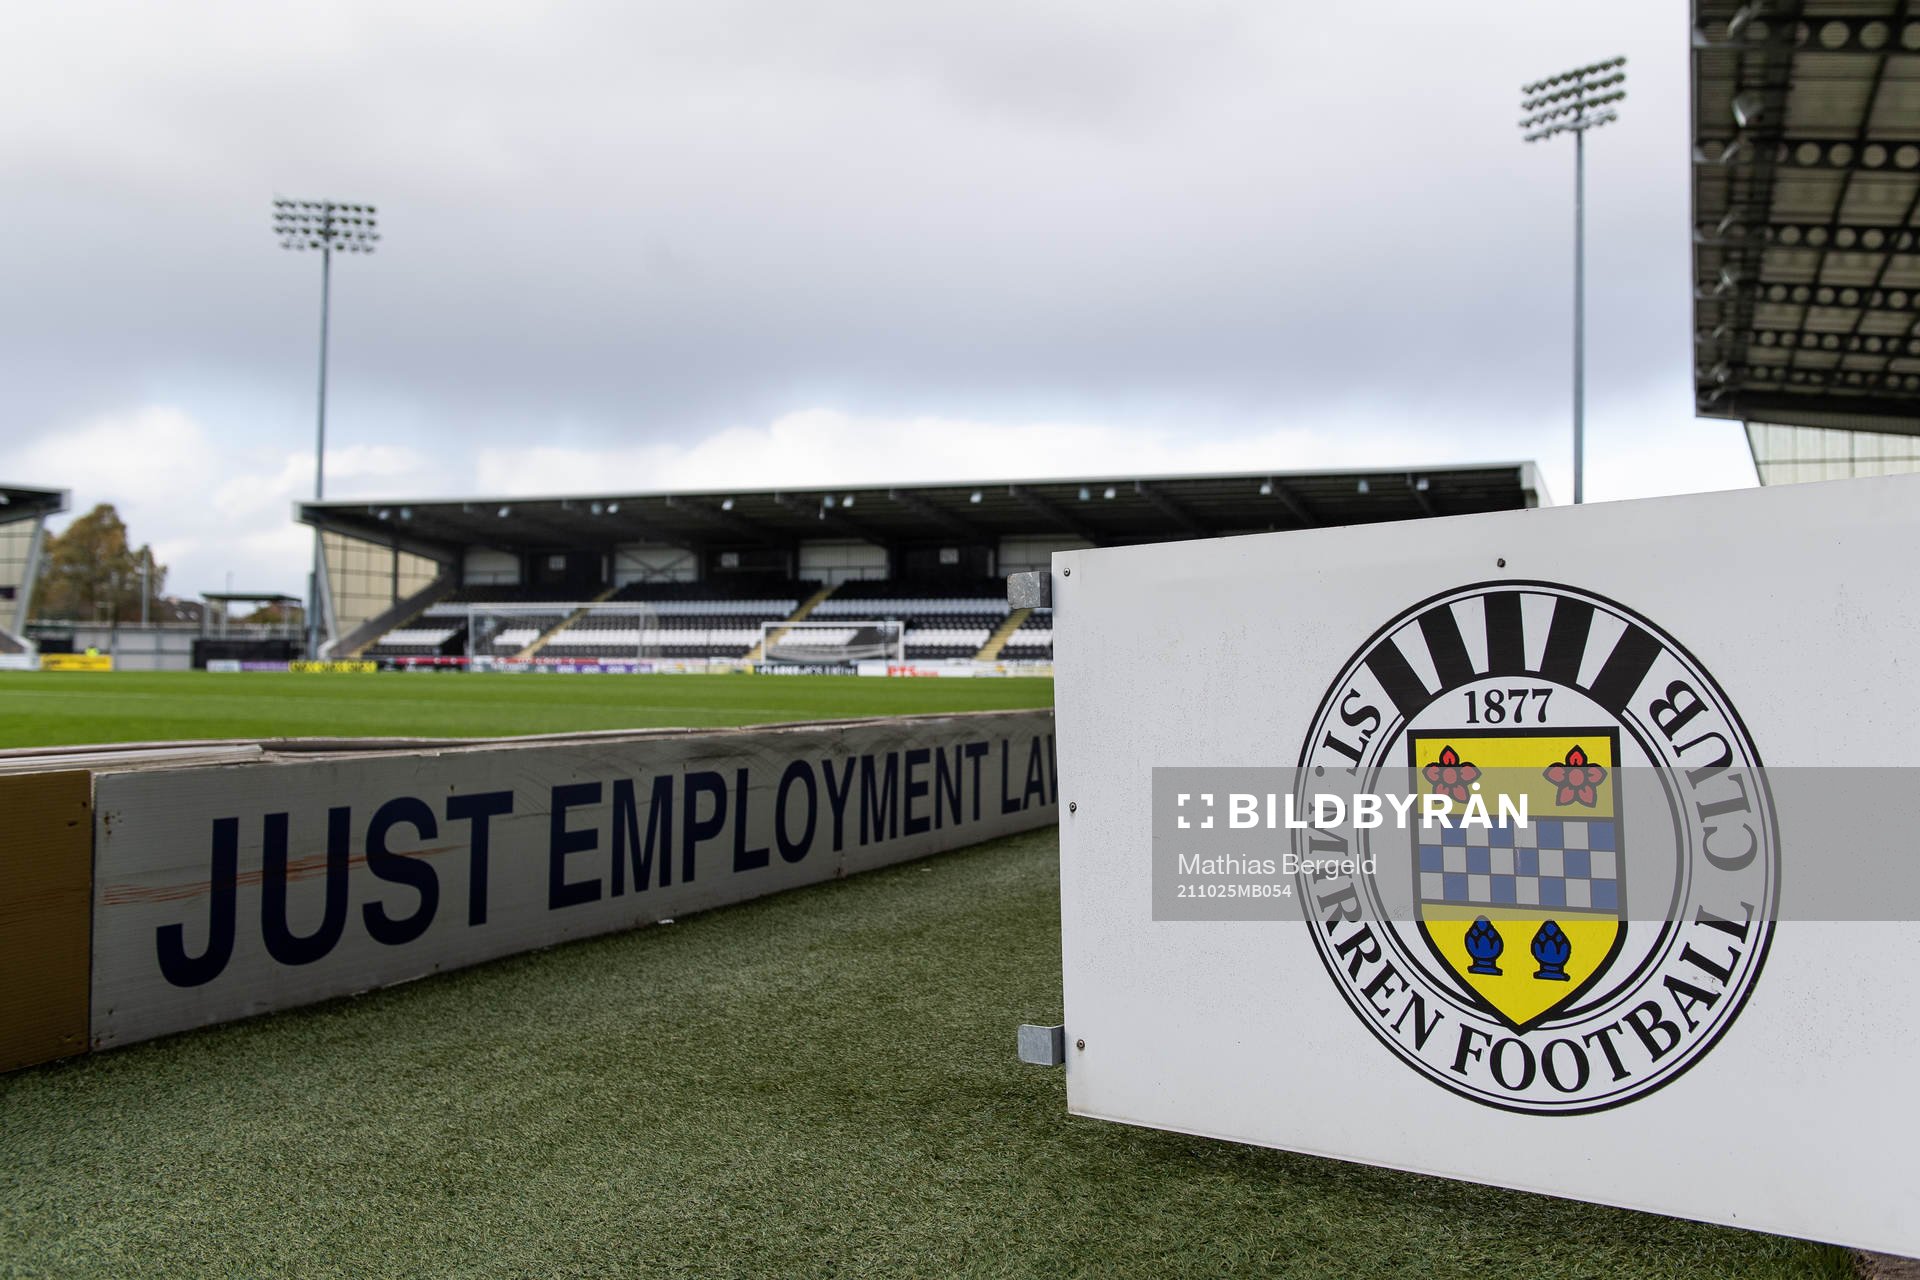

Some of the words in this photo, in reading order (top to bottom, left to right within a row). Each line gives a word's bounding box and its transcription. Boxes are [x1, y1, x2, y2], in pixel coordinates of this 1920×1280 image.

[1464, 687, 1554, 724] 1877
[156, 790, 514, 988] JUST
[548, 740, 990, 911] EMPLOYMENT
[1308, 803, 1445, 1052] MIRREN
[1449, 900, 1756, 1093] FOOTBALL
[1648, 678, 1759, 872] CLUB
